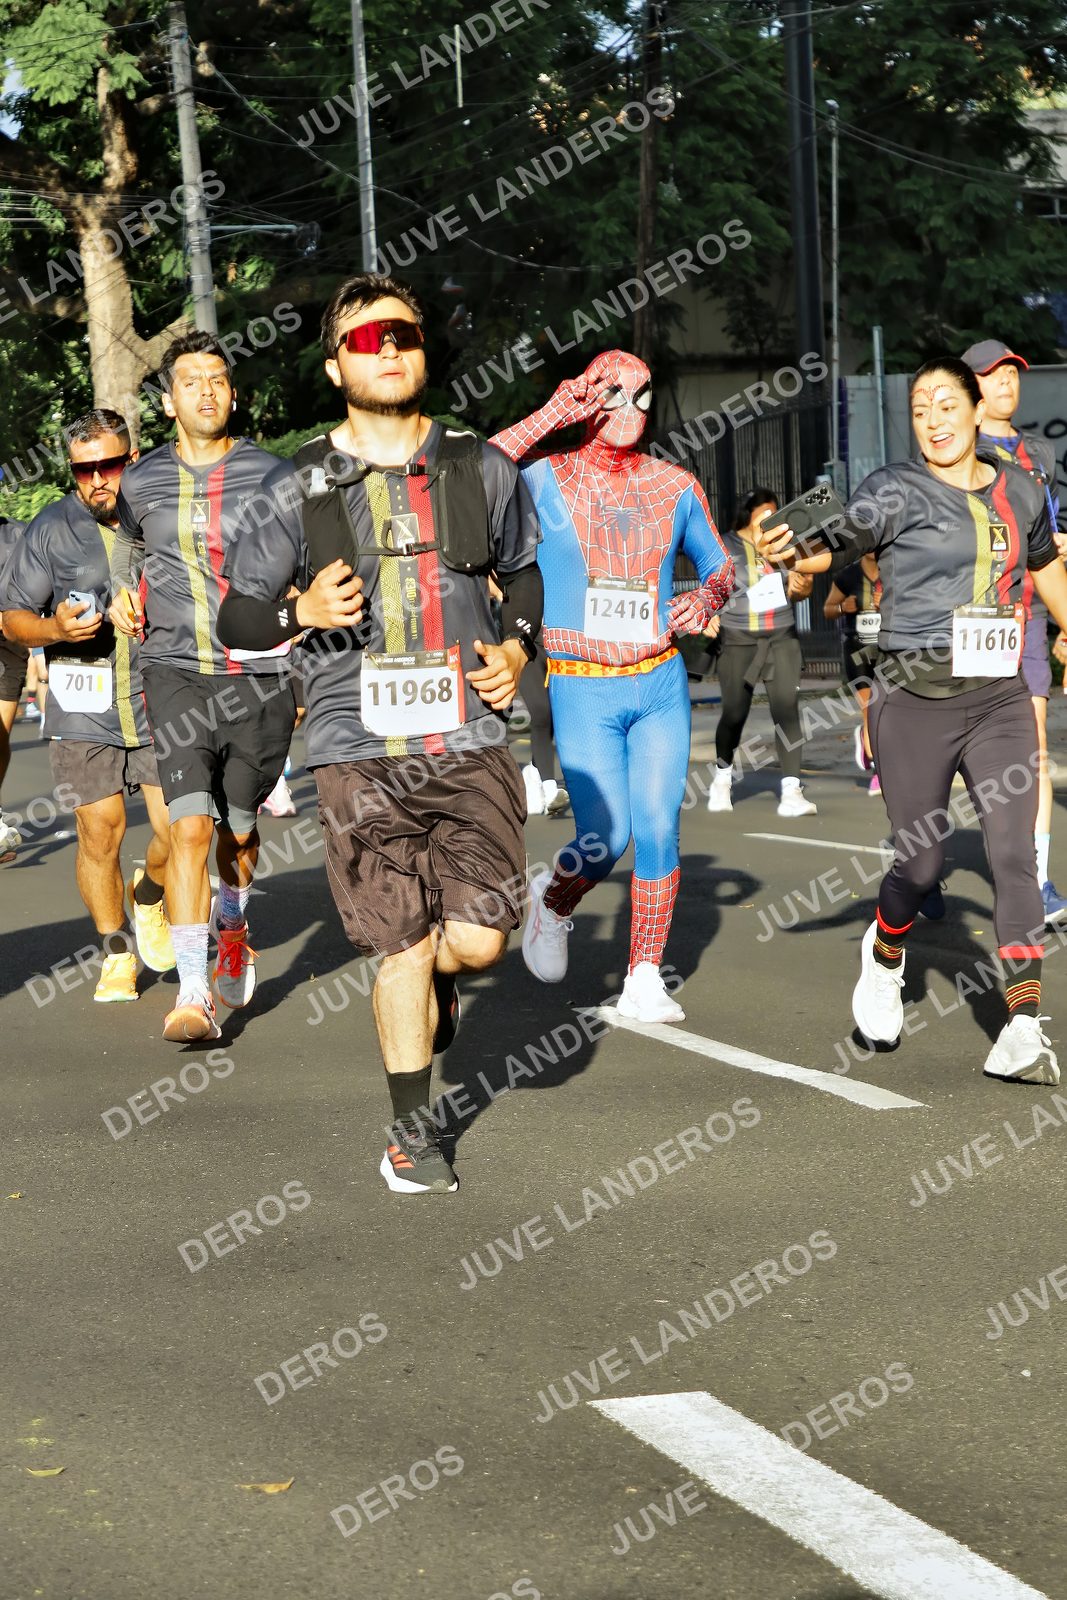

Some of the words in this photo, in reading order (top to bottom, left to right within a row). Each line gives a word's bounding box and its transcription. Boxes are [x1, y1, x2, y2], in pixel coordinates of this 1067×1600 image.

[590, 597, 650, 620] 12416
[959, 628, 1017, 651] 11616
[367, 676, 453, 706] 11968
